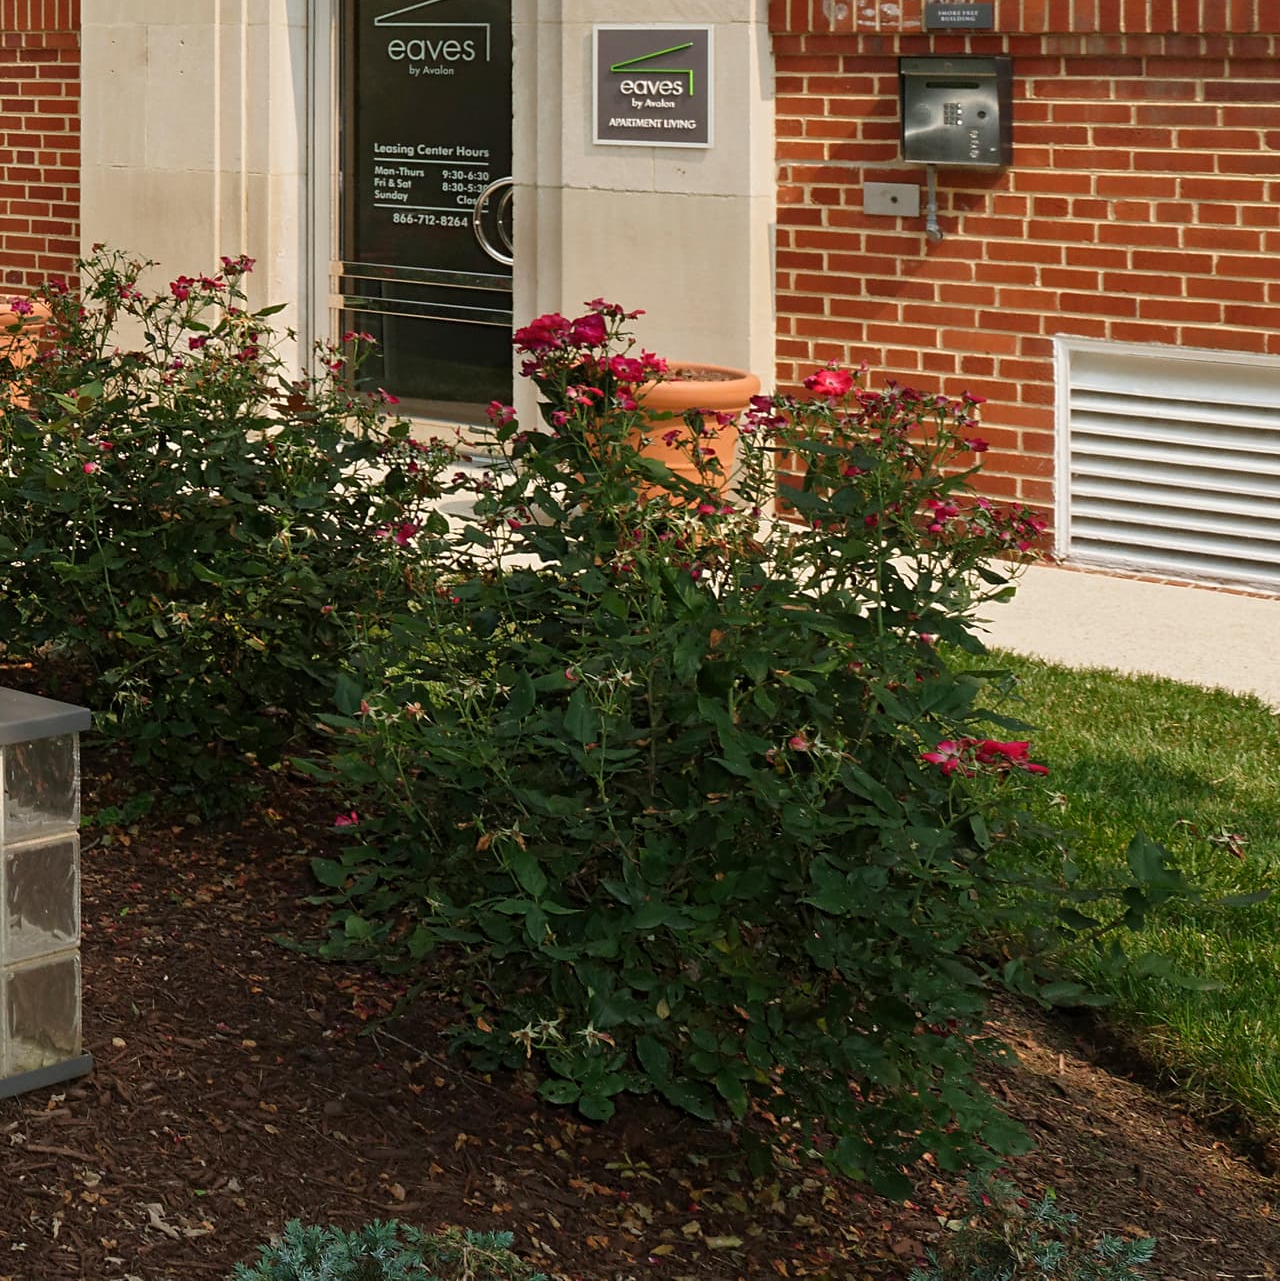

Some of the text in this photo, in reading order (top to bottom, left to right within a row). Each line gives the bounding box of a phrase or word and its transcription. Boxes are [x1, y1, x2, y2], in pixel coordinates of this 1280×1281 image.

[388, 39, 476, 61] eaves
[409, 64, 454, 77] by Avalon
[620, 79, 684, 95] eaves
[631, 98, 676, 109] by Avalon
[608, 118, 697, 129] APARTMENT LIVING
[374, 143, 489, 157] Leasing Center Hours
[374, 166, 489, 181] Mon-Thurs 9:30-6:30
[374, 178, 386, 187] Fri
[388, 178, 395, 188] &
[397, 179, 412, 188] Sat
[374, 190, 409, 202] Sunday
[393, 213, 468, 227] 866-712-8264
